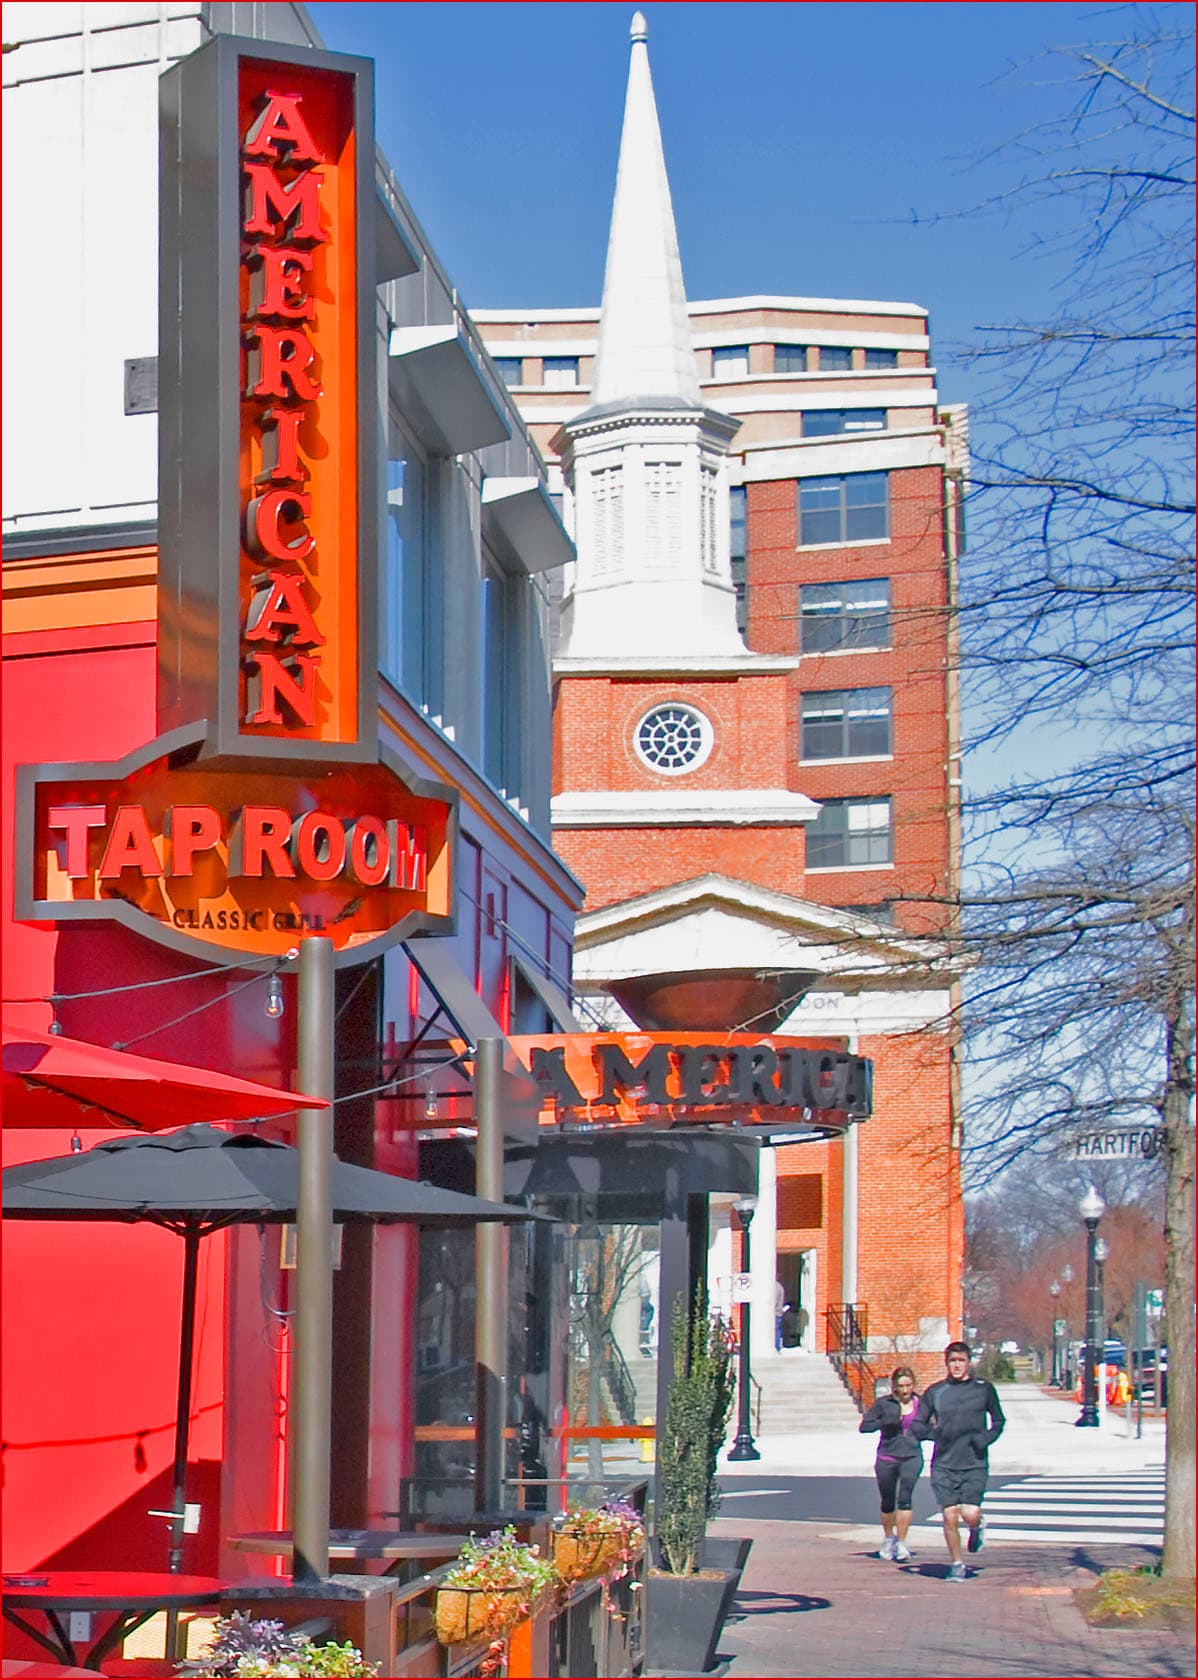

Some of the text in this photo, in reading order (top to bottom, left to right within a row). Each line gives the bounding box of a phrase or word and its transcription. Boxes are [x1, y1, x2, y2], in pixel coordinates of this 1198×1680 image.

[244, 89, 327, 727] AMERICAN
[47, 805, 427, 892] TAP ROOM
[172, 908, 266, 932] CLASSIC
